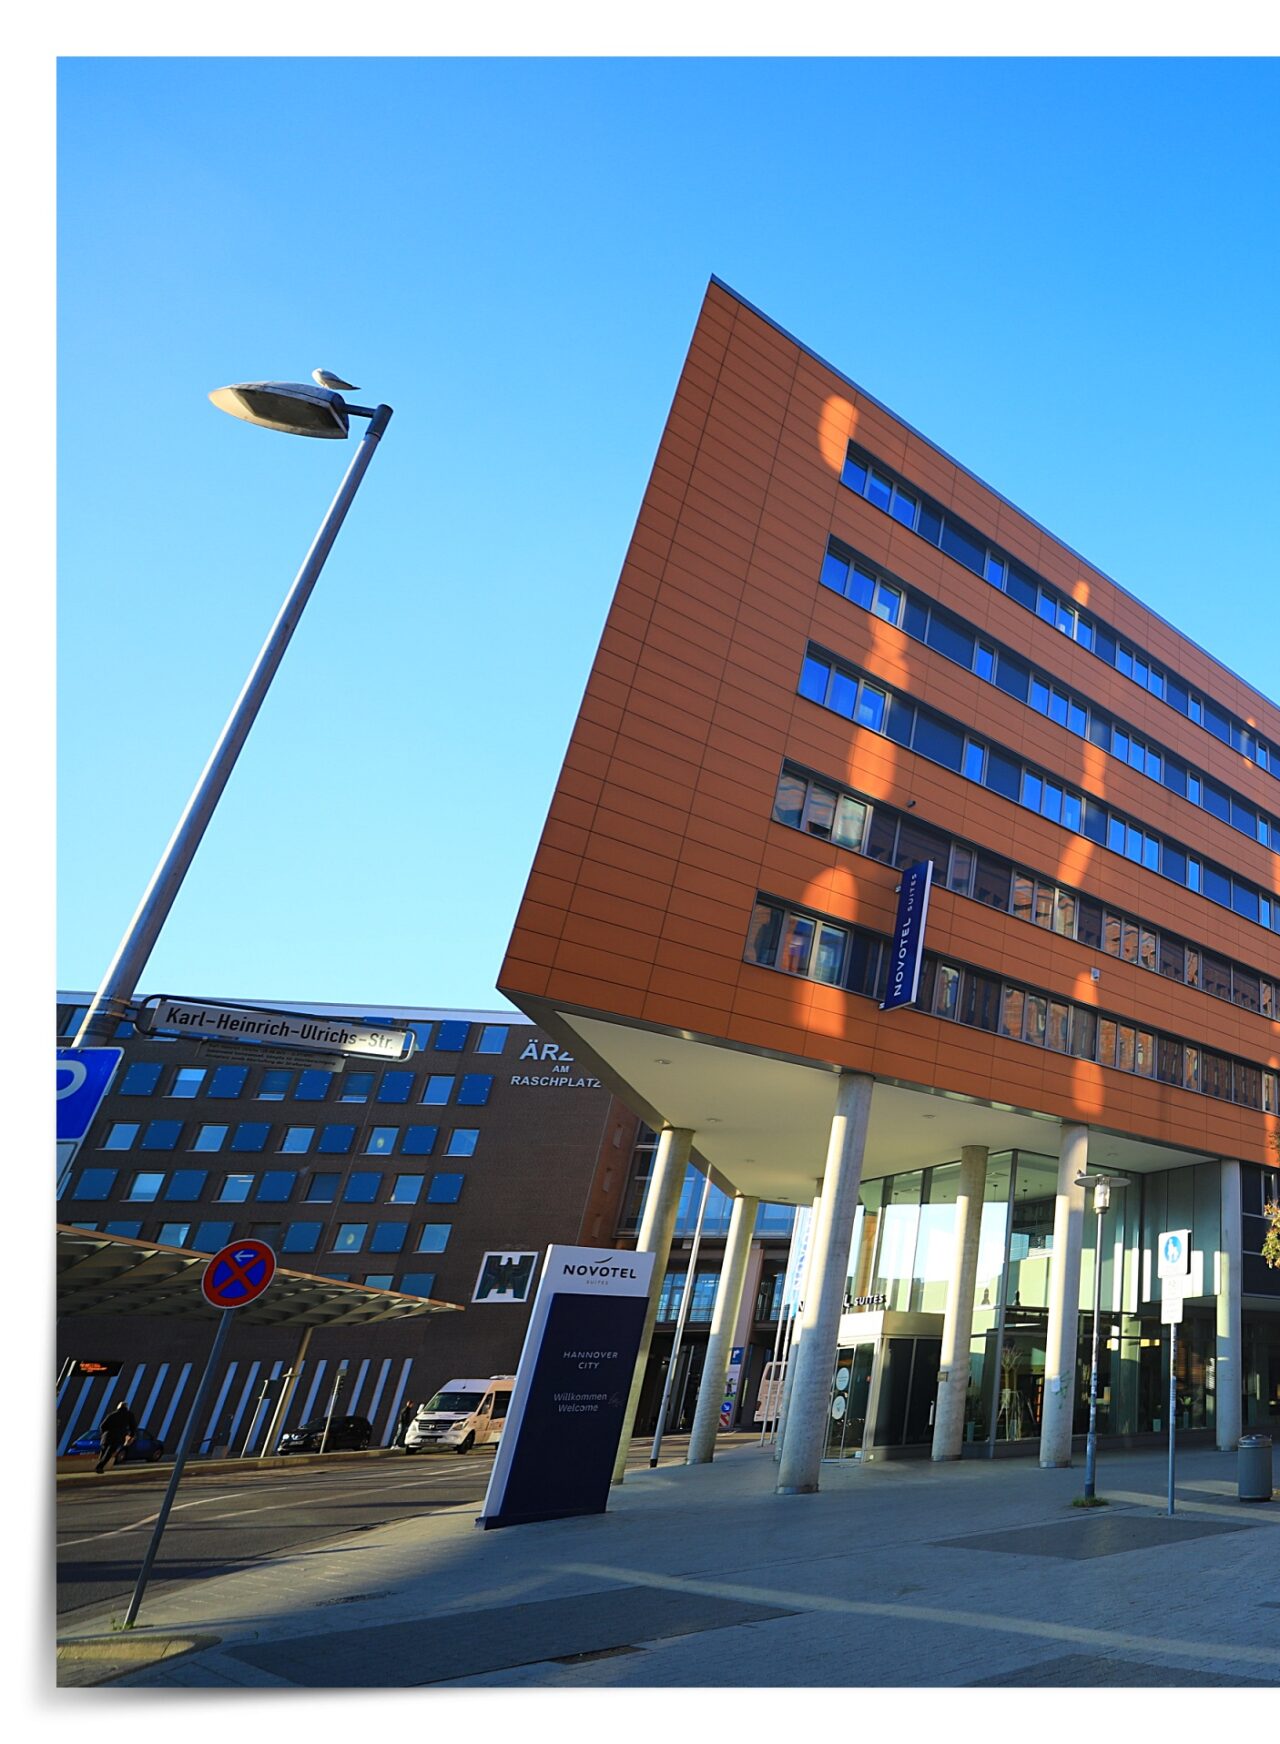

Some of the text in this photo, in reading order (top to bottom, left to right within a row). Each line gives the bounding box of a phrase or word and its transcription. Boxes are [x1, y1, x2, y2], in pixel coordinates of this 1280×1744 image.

[893, 873, 917, 997] NOVOTEL SUITES
[166, 1007, 394, 1050] Karl-Heinrich-Ulrichs-Str.
[552, 1065, 570, 1073] AM
[510, 1075, 602, 1088] RASCHPLATZ
[563, 1264, 637, 1279] NOVOTEL
[854, 1294, 886, 1307] SUITES
[563, 1351, 619, 1359] HANNOVER
[553, 1392, 608, 1401] Willkommen
[558, 1403, 599, 1412] Welcome
